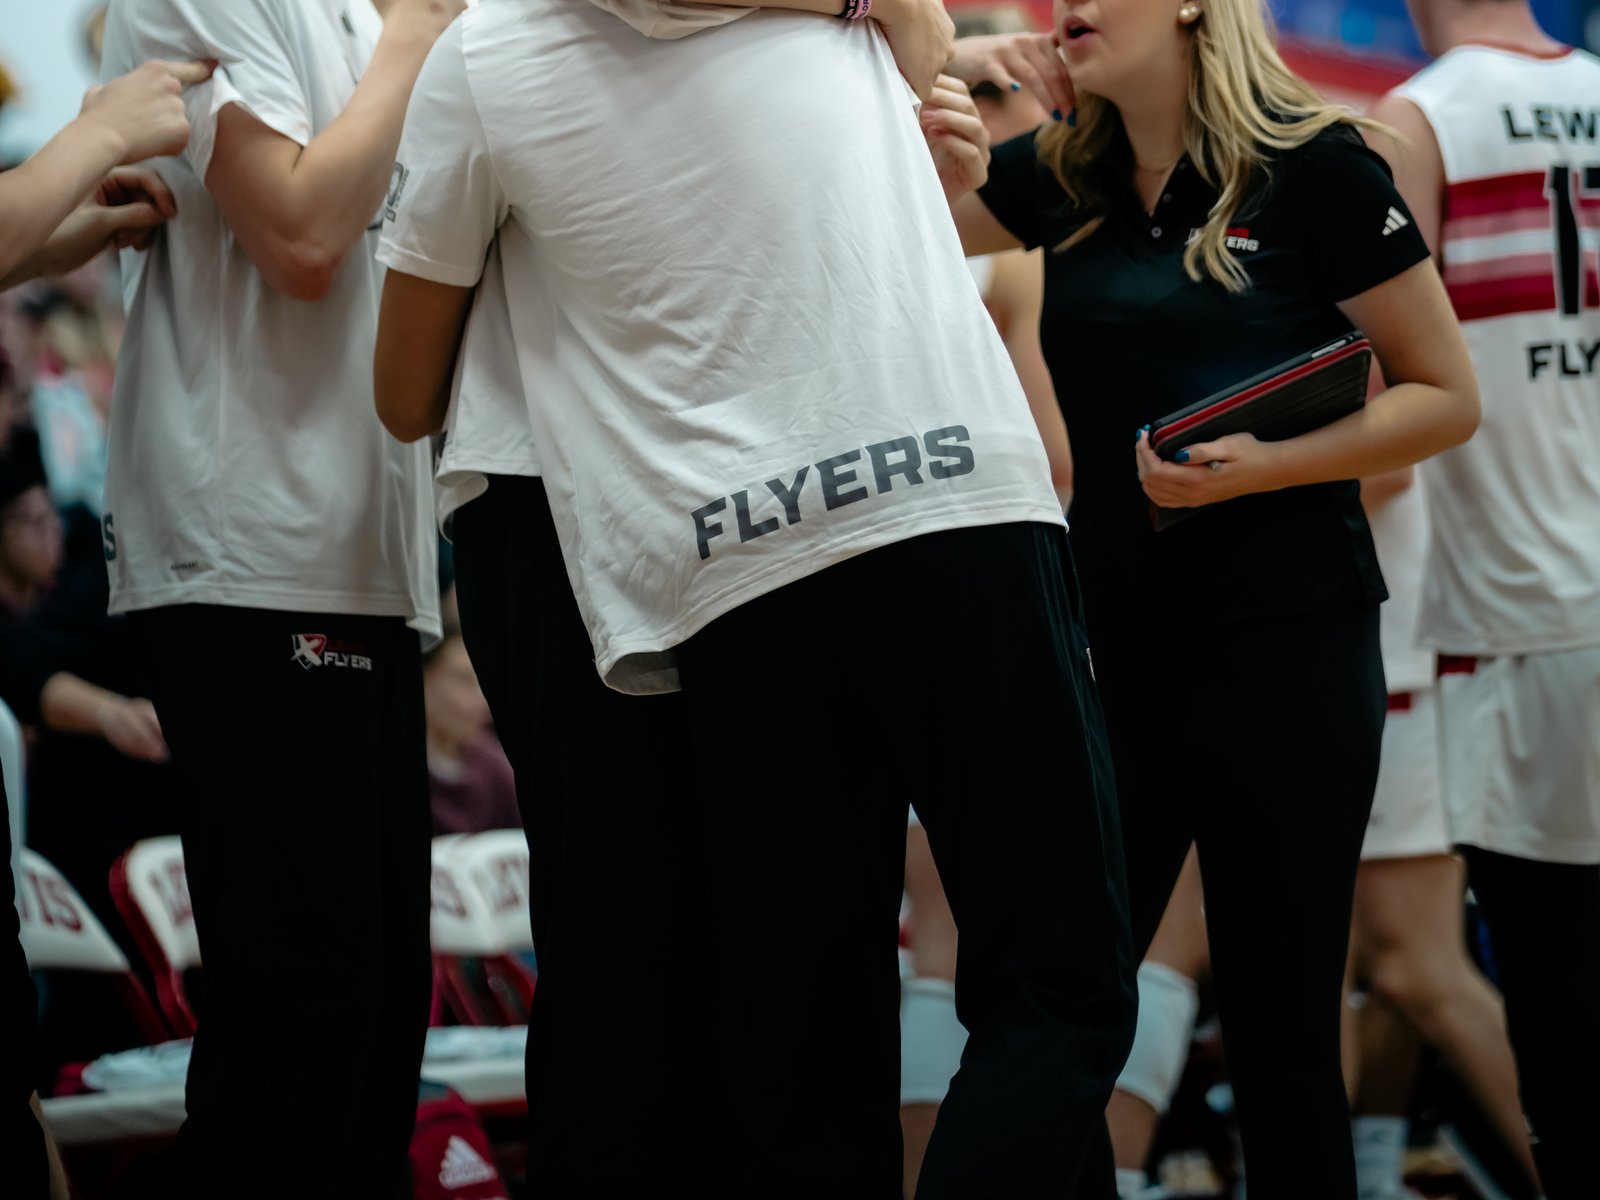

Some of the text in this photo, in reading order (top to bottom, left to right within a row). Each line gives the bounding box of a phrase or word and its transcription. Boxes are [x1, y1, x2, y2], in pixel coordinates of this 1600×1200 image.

[1500, 104, 1596, 143] LEW
[691, 424, 975, 560] FLYERS
[323, 651, 372, 671] FLYERS
